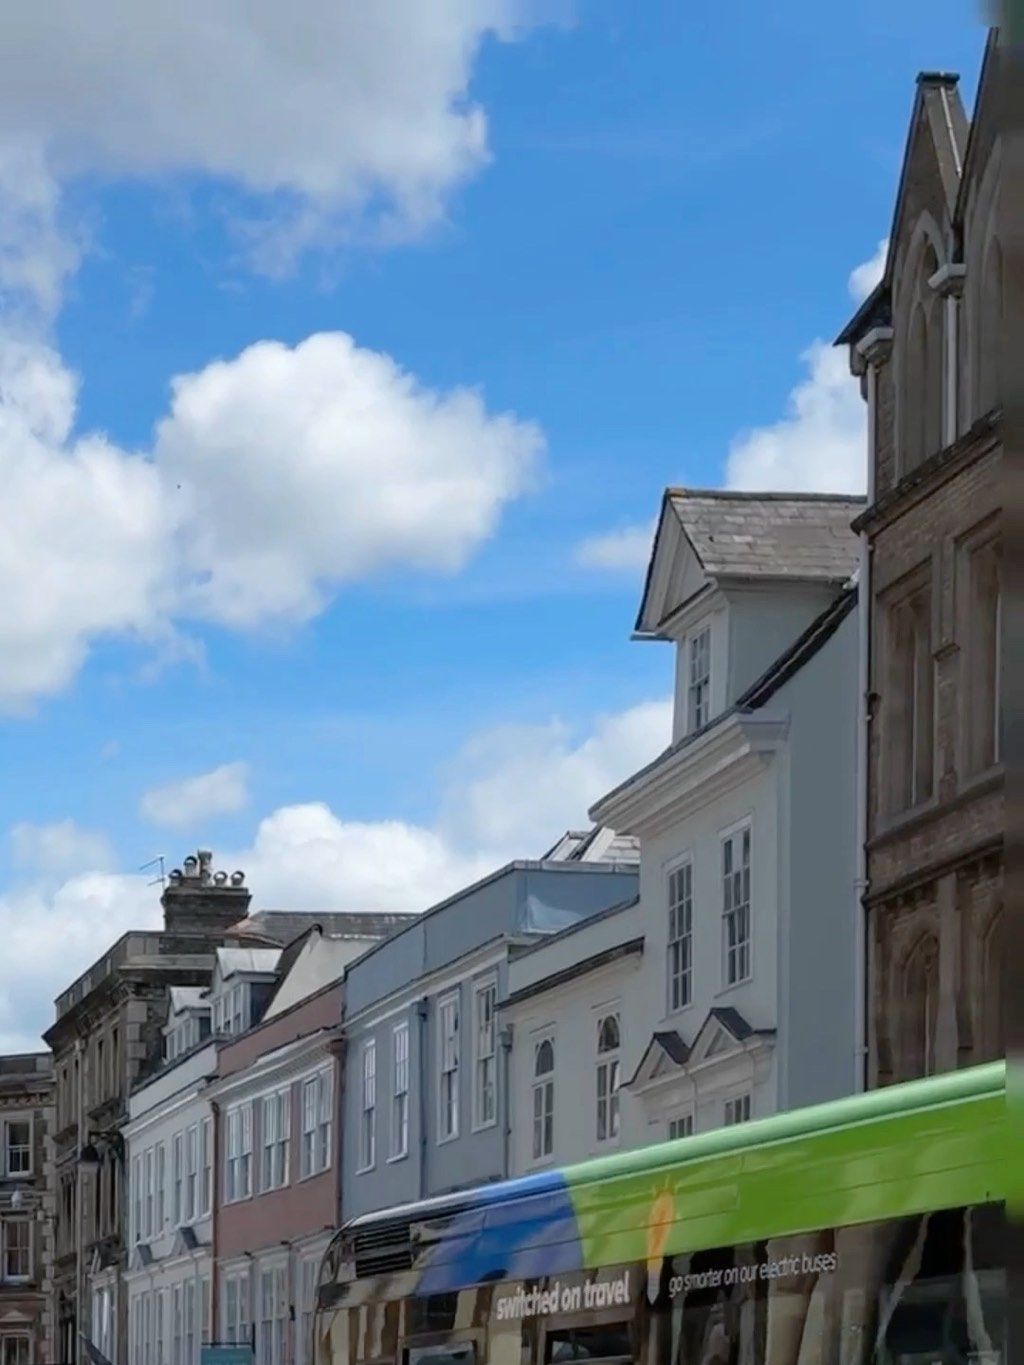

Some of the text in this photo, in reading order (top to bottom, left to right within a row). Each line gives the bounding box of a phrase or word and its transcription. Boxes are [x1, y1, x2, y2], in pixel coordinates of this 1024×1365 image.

[496, 1269, 631, 1320] switched on travel
[668, 1252, 837, 1298] go smarter on our electric buses
